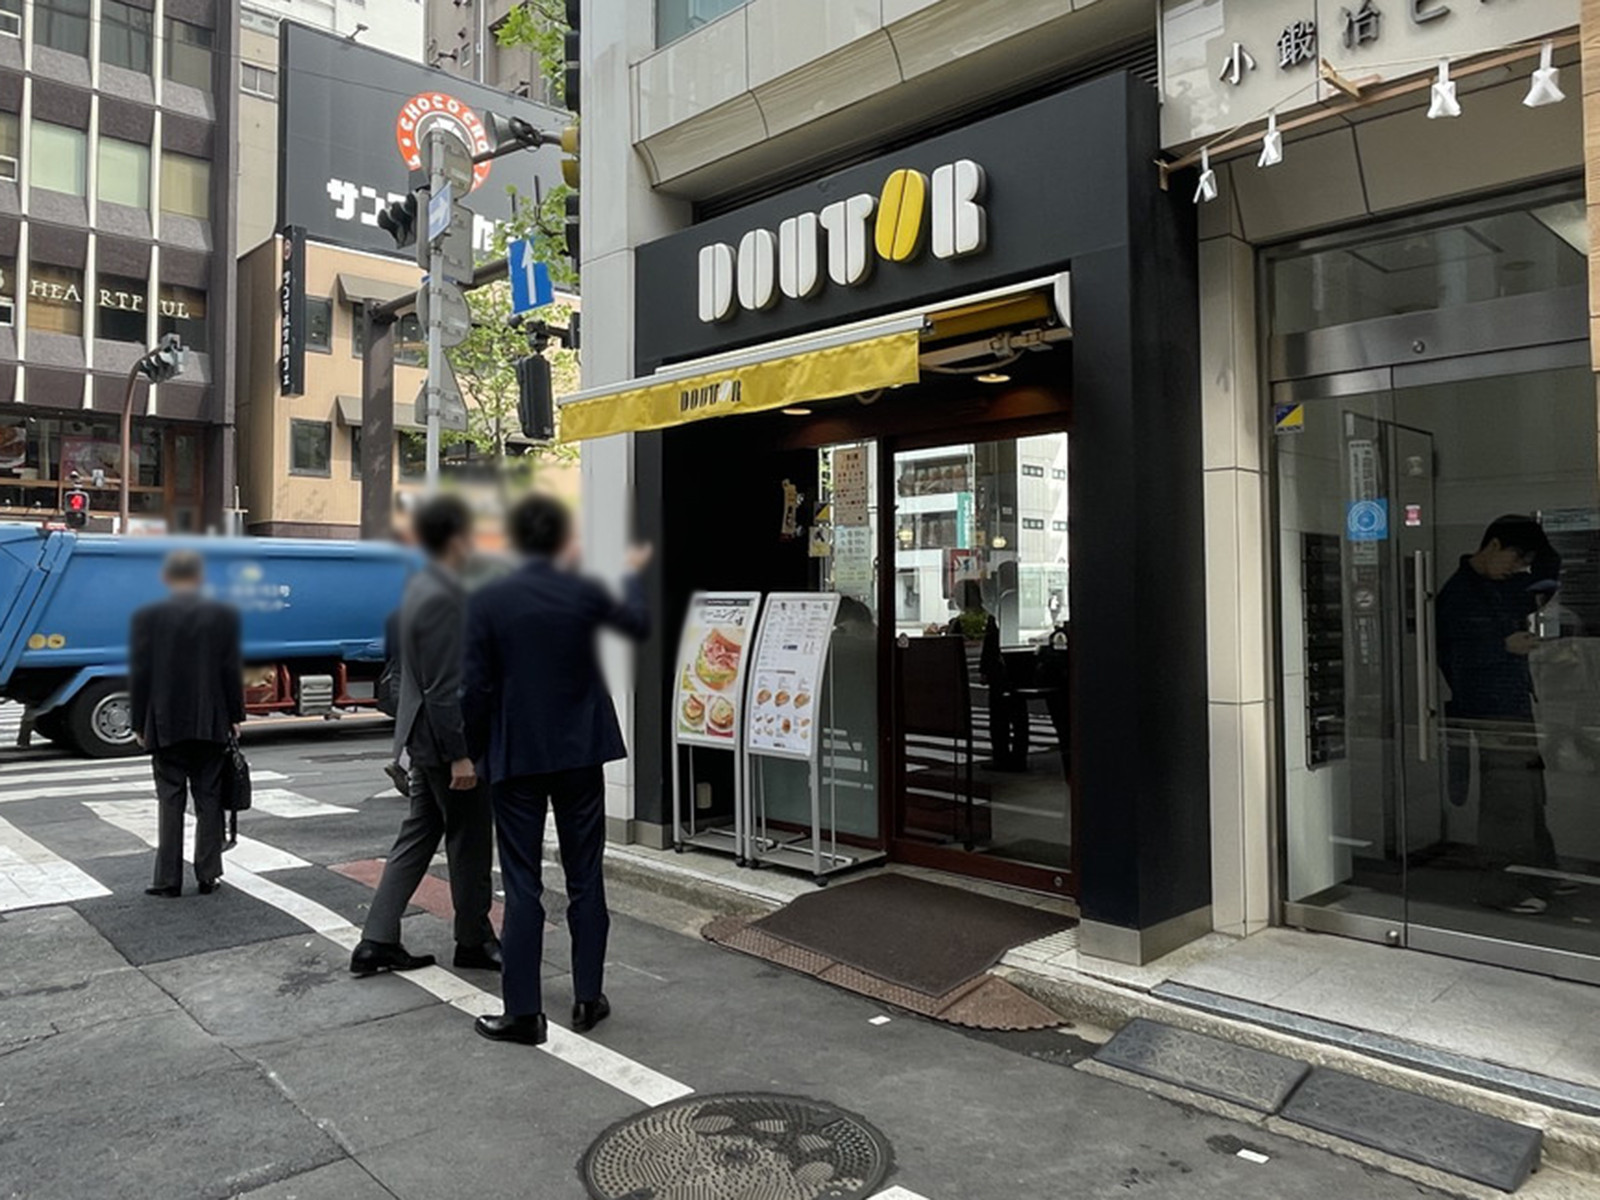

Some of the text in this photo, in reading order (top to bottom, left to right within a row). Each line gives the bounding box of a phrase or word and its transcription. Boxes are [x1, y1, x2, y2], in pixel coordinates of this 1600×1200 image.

[400, 94, 460, 131] CHOCO
[699, 159, 983, 322] DOUTOR
[681, 379, 742, 412] DOUTOR
